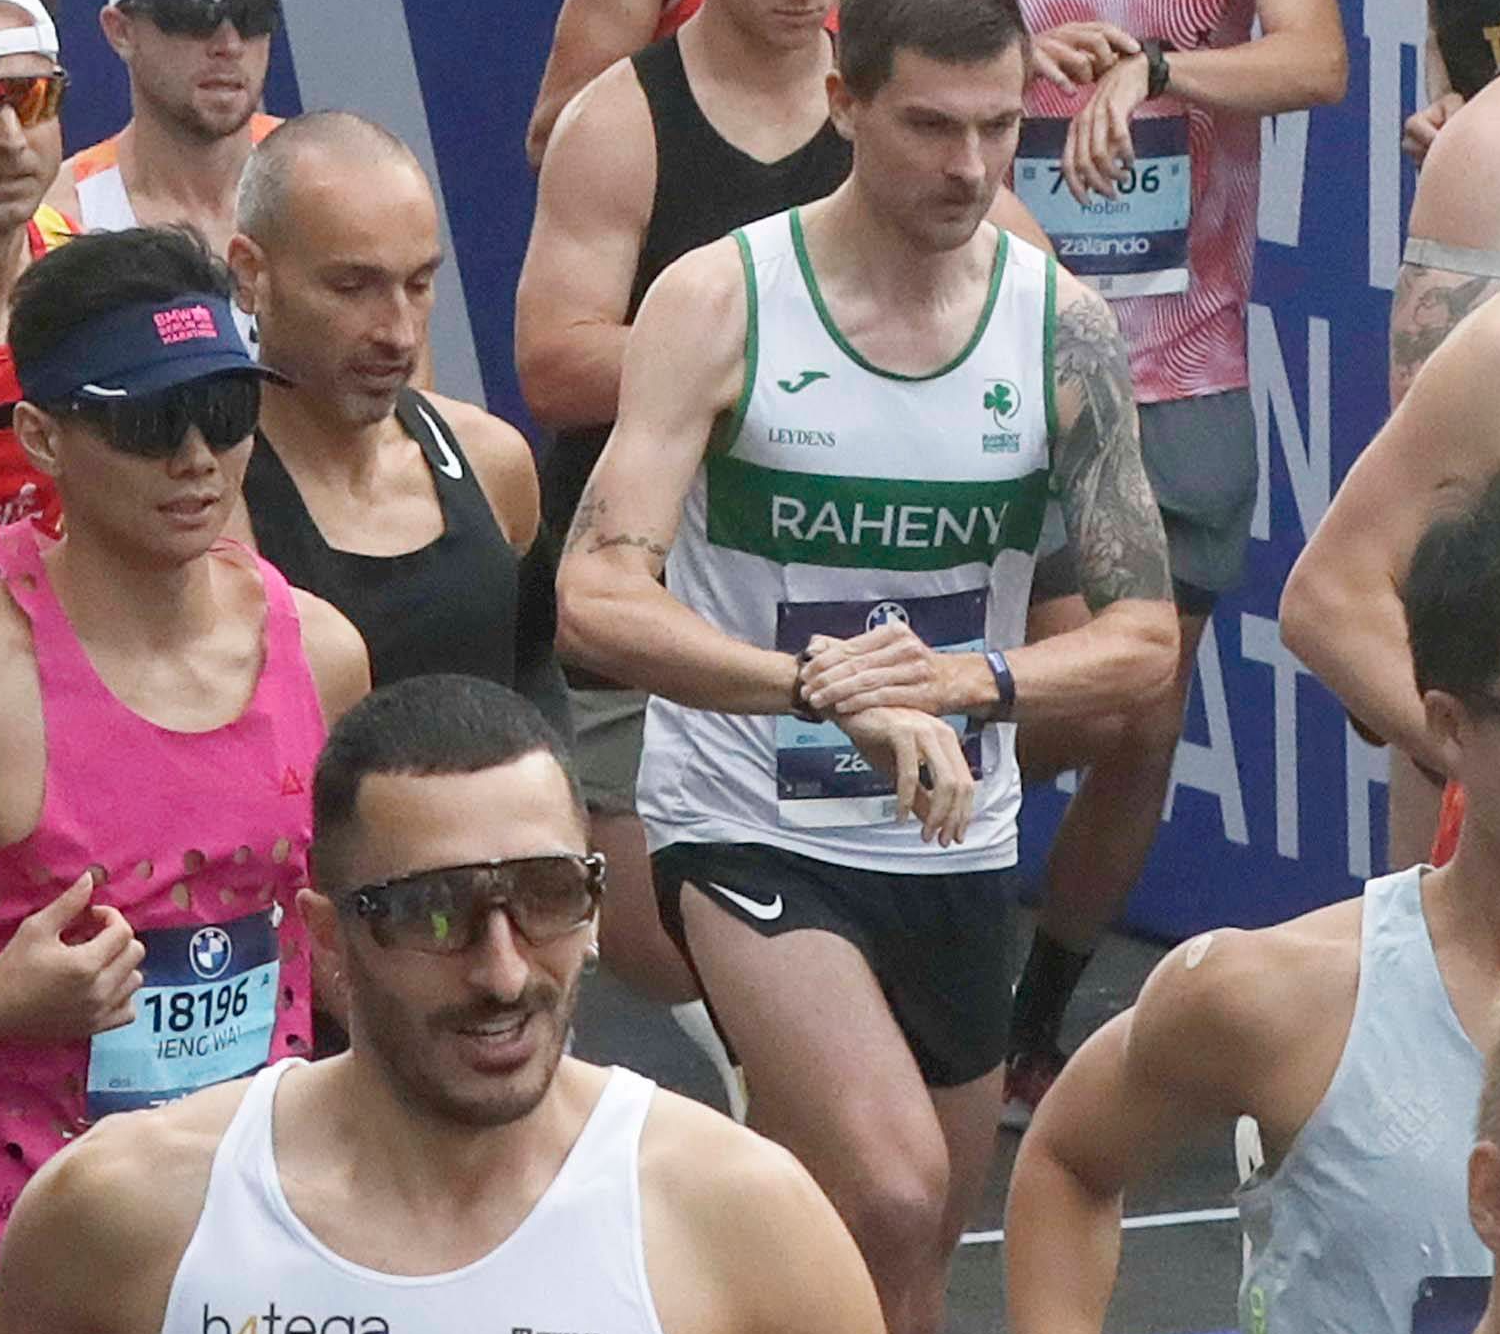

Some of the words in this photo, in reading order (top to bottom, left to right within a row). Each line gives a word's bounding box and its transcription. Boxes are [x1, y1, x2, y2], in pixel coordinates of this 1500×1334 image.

[1047, 164, 1161, 197] 706
[1057, 237, 1151, 258] zalando
[767, 426, 836, 449] LEYDENS
[769, 494, 1012, 550] RAHENY
[142, 976, 250, 1035] 18196
